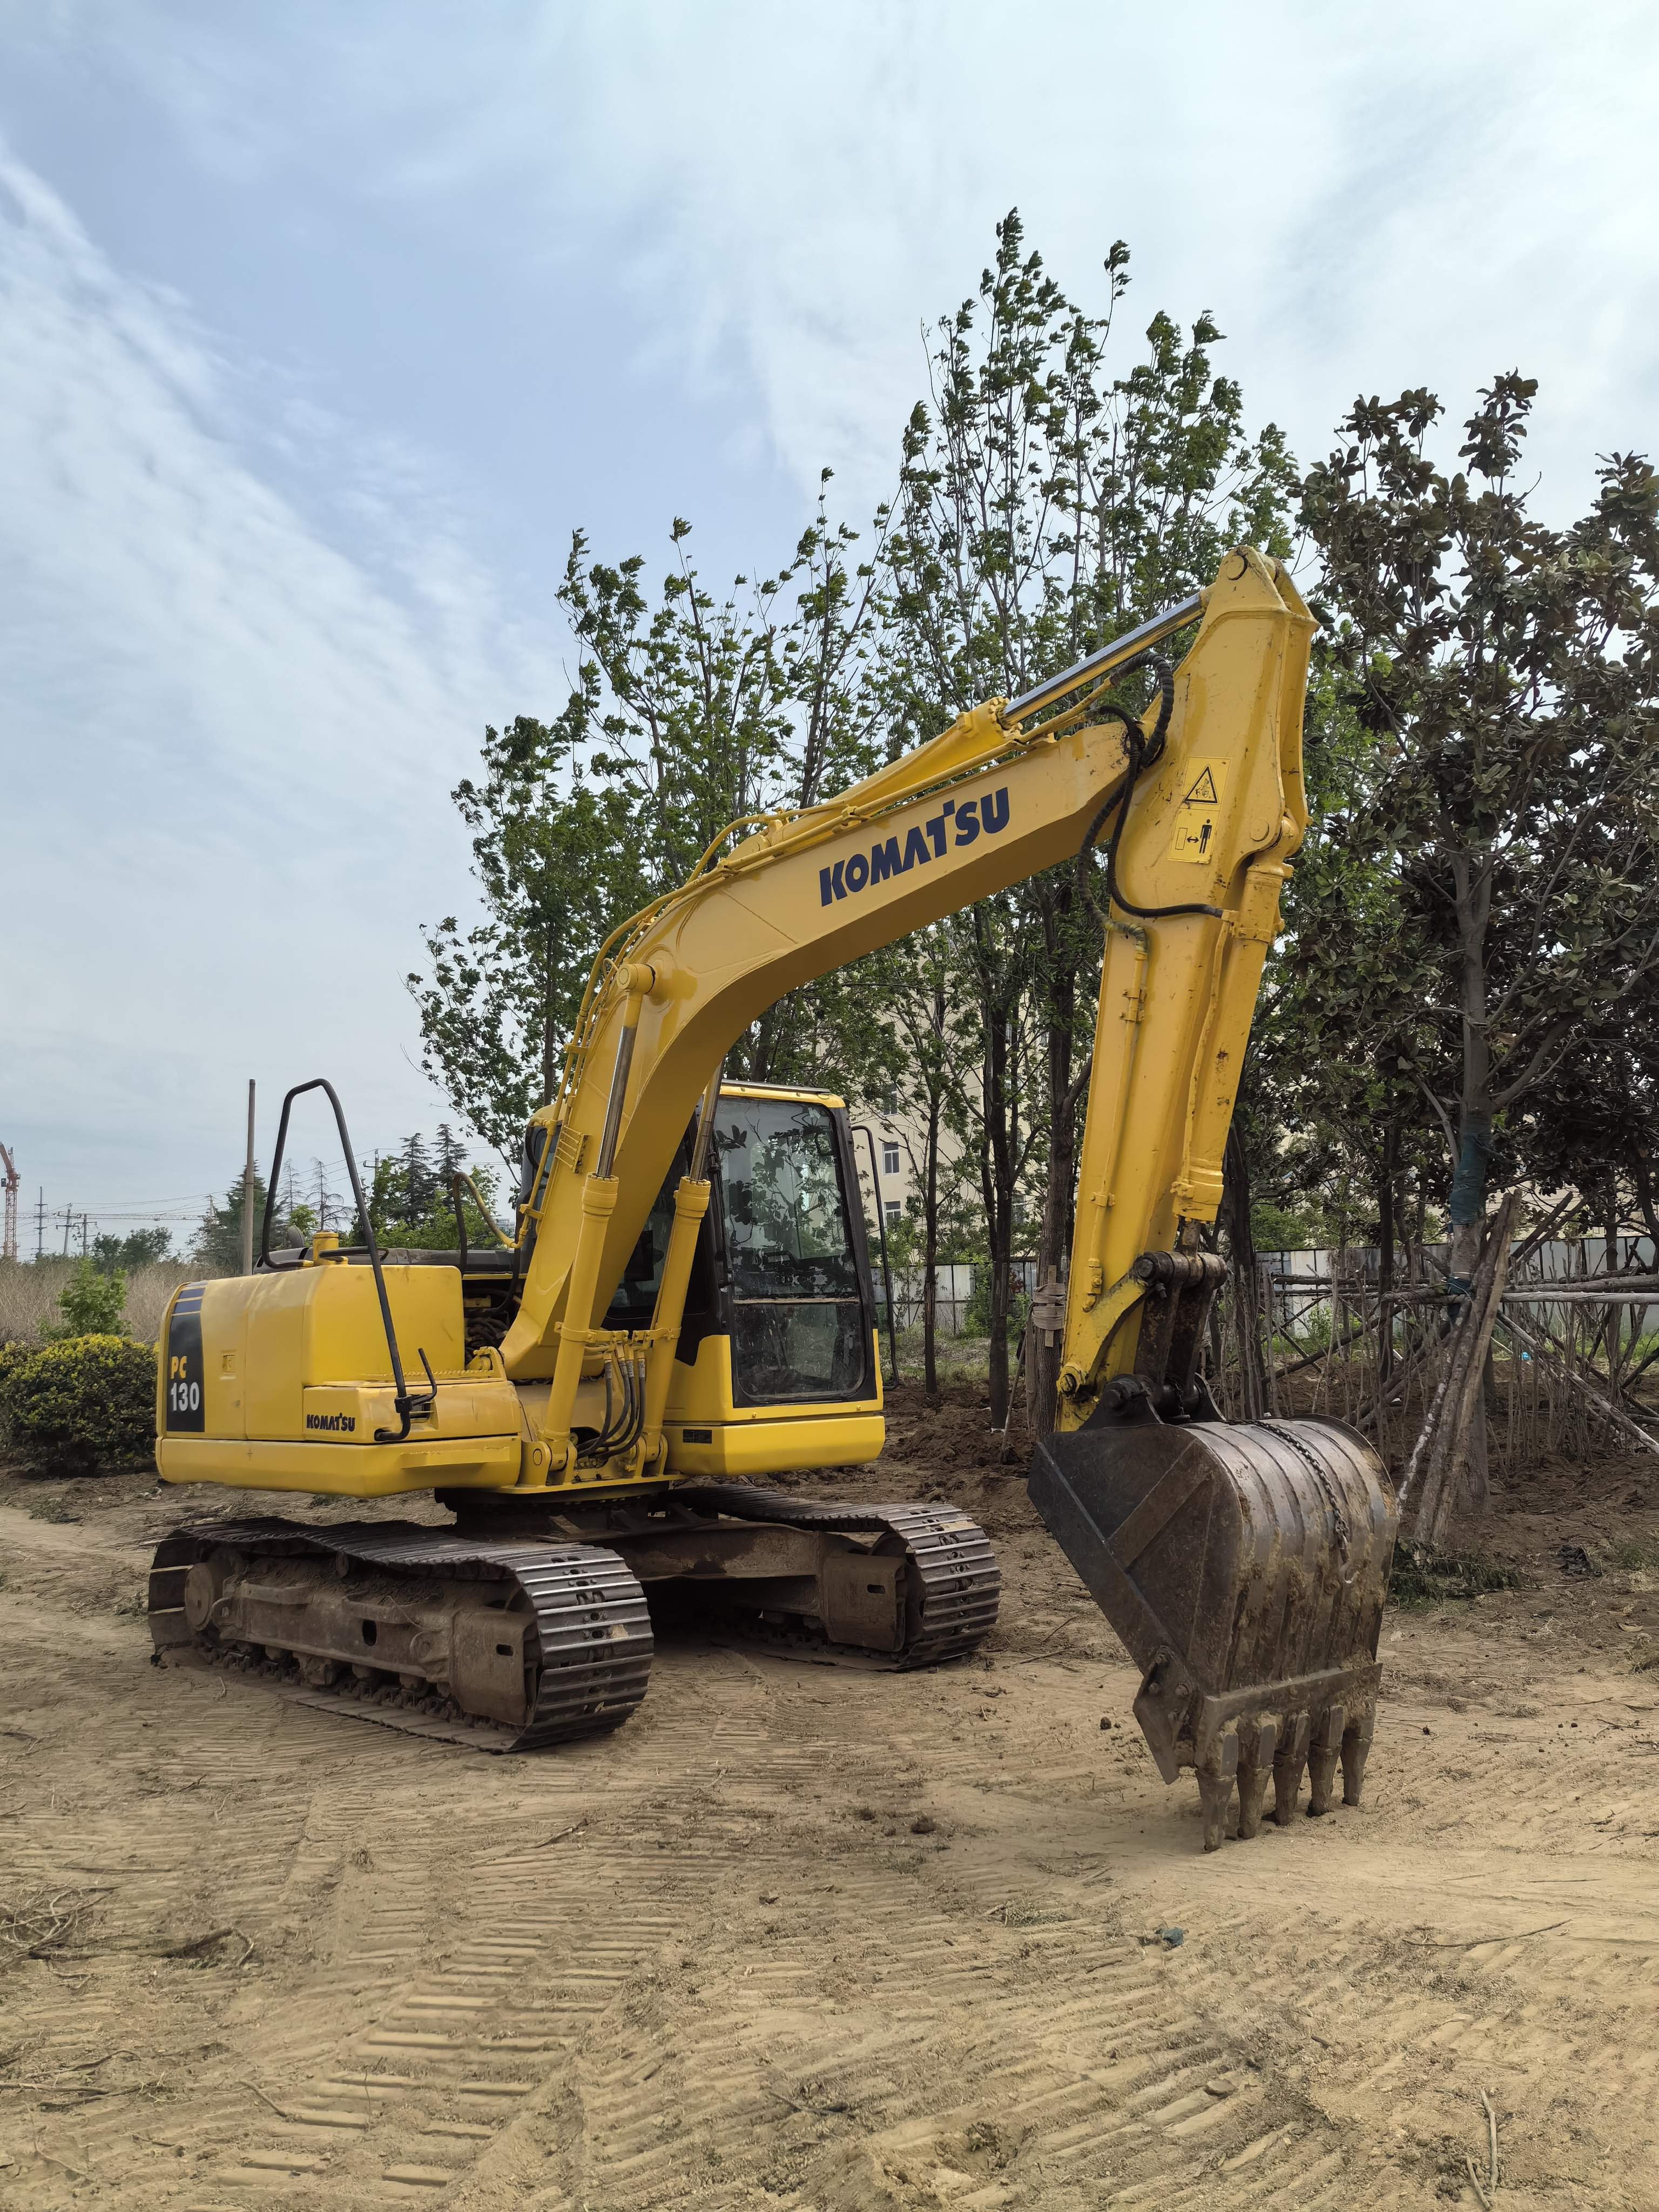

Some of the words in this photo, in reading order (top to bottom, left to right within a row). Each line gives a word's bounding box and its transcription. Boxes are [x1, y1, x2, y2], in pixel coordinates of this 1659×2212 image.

[819, 787, 1010, 907] KOMATSU
[171, 1356, 187, 1379] PC
[171, 1382, 199, 1411] 130
[307, 1412, 355, 1432] KOMATSU
